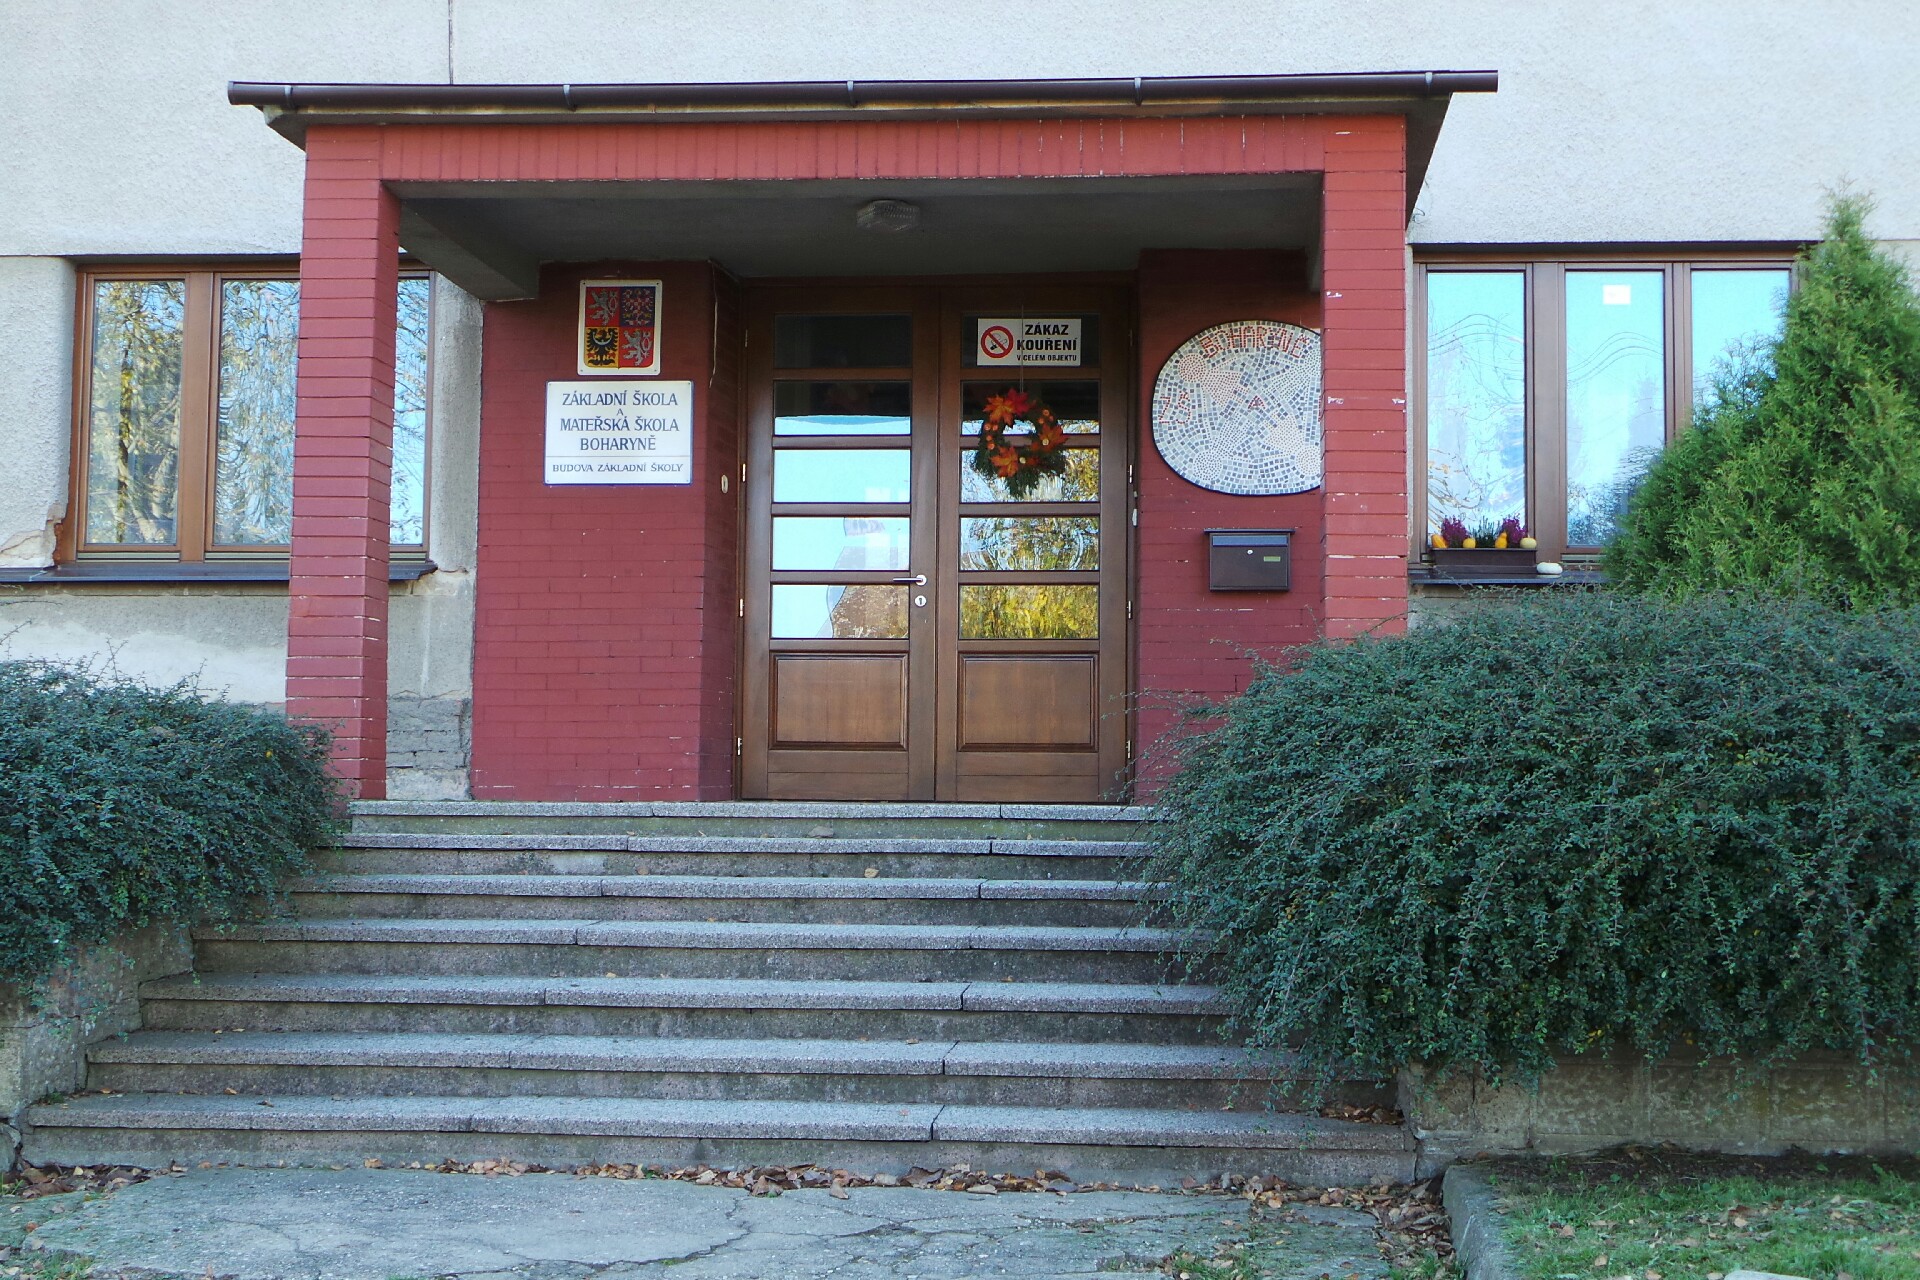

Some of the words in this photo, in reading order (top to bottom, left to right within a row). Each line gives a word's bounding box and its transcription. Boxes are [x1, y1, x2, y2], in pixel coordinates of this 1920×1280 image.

[1025, 322, 1069, 336] ZÁKAZ
[1016, 338, 1078, 350] KOUŘENÍ
[1200, 326, 1309, 359] BOHARYNĚ
[562, 390, 627, 406] ZÁKLADNÍ
[632, 390, 678, 406] ŠKOLA
[616, 408, 624, 416] A
[560, 416, 631, 432] MATEŘSKÁ
[634, 416, 680, 432] ŠKOLA
[580, 434, 656, 451] BOHARYNĚ
[552, 464, 594, 472] BUDOVA
[597, 462, 647, 472] ZÁKLADNÍ
[650, 462, 684, 472] ŠKOLY
